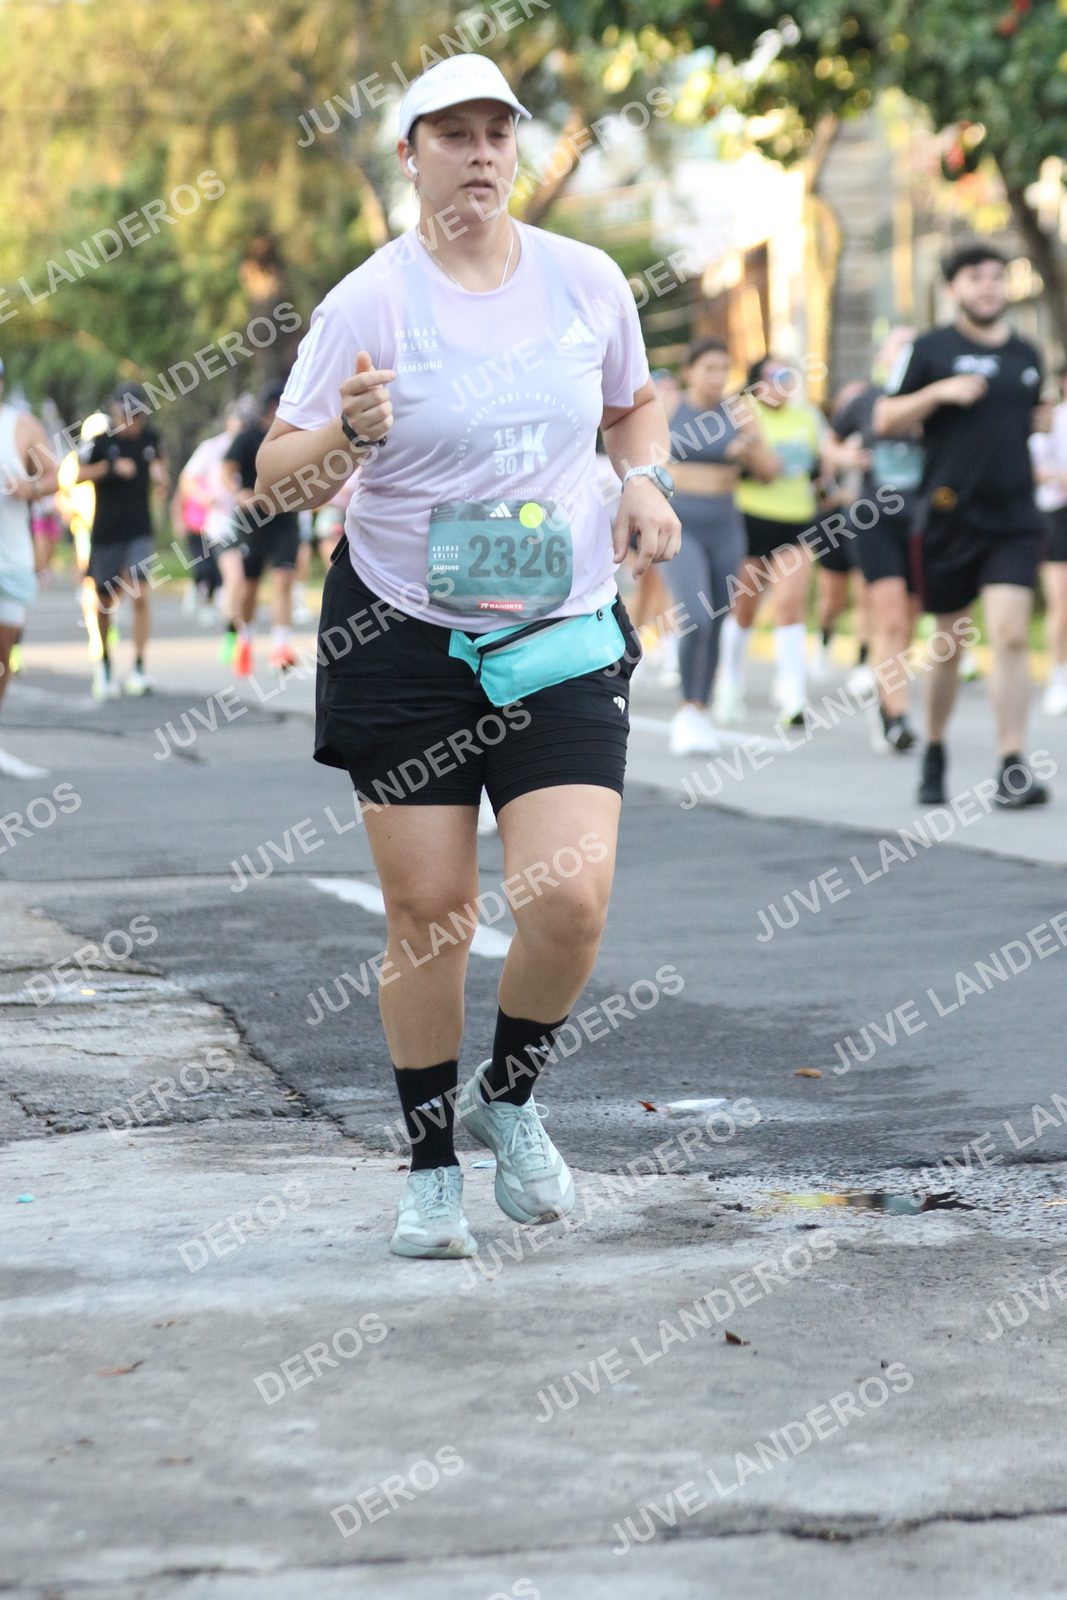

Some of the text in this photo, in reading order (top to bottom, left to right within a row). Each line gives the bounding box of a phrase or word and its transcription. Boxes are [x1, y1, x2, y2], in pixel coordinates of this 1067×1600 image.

[494, 427, 516, 449] 15
[521, 422, 551, 474] K
[494, 455, 517, 476] 30
[468, 535, 568, 578] 2326
